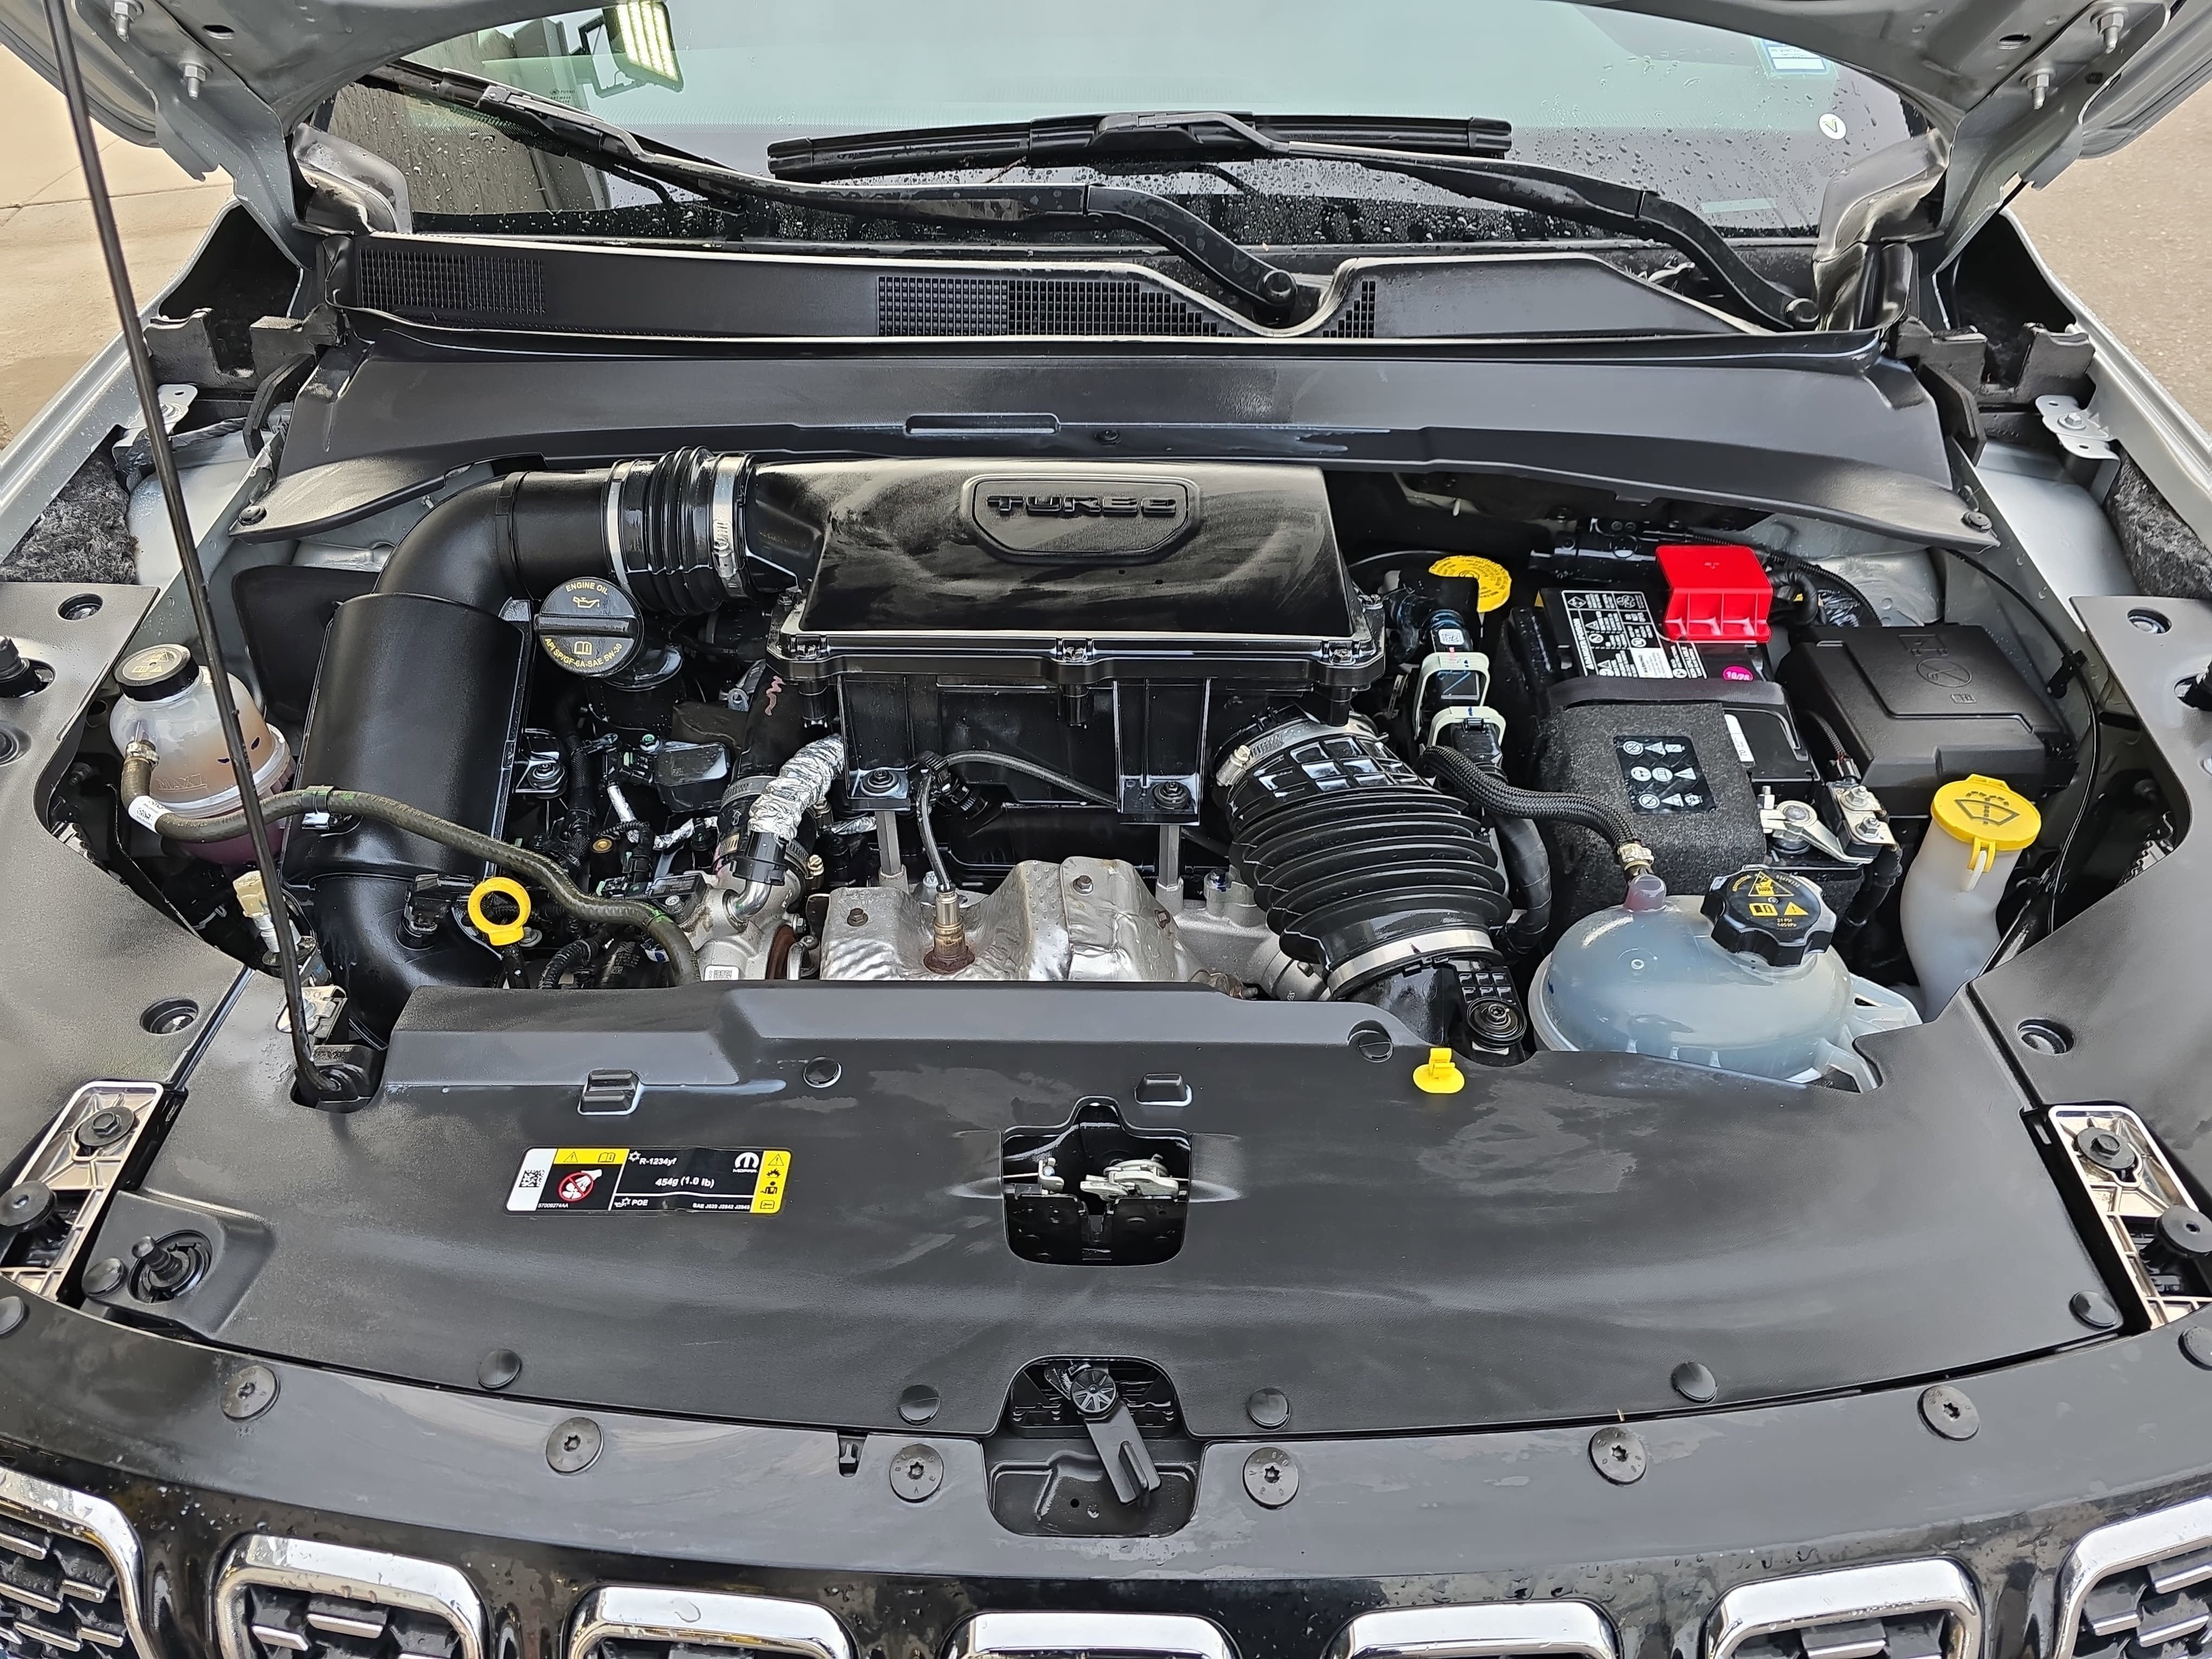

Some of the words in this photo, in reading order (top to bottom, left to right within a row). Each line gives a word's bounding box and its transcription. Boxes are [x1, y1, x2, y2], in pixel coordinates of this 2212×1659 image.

[987, 494, 1177, 516] TURBO
[565, 581, 596, 593] ENGINE
[596, 584, 608, 596] OIL
[545, 638, 556, 651] API
[603, 643, 623, 662] 5W-30
[639, 1158, 677, 1166] R-1234yf
[655, 1178, 679, 1187] 454g
[680, 1176, 699, 1186] (1.0
[700, 1178, 715, 1189] lb)
